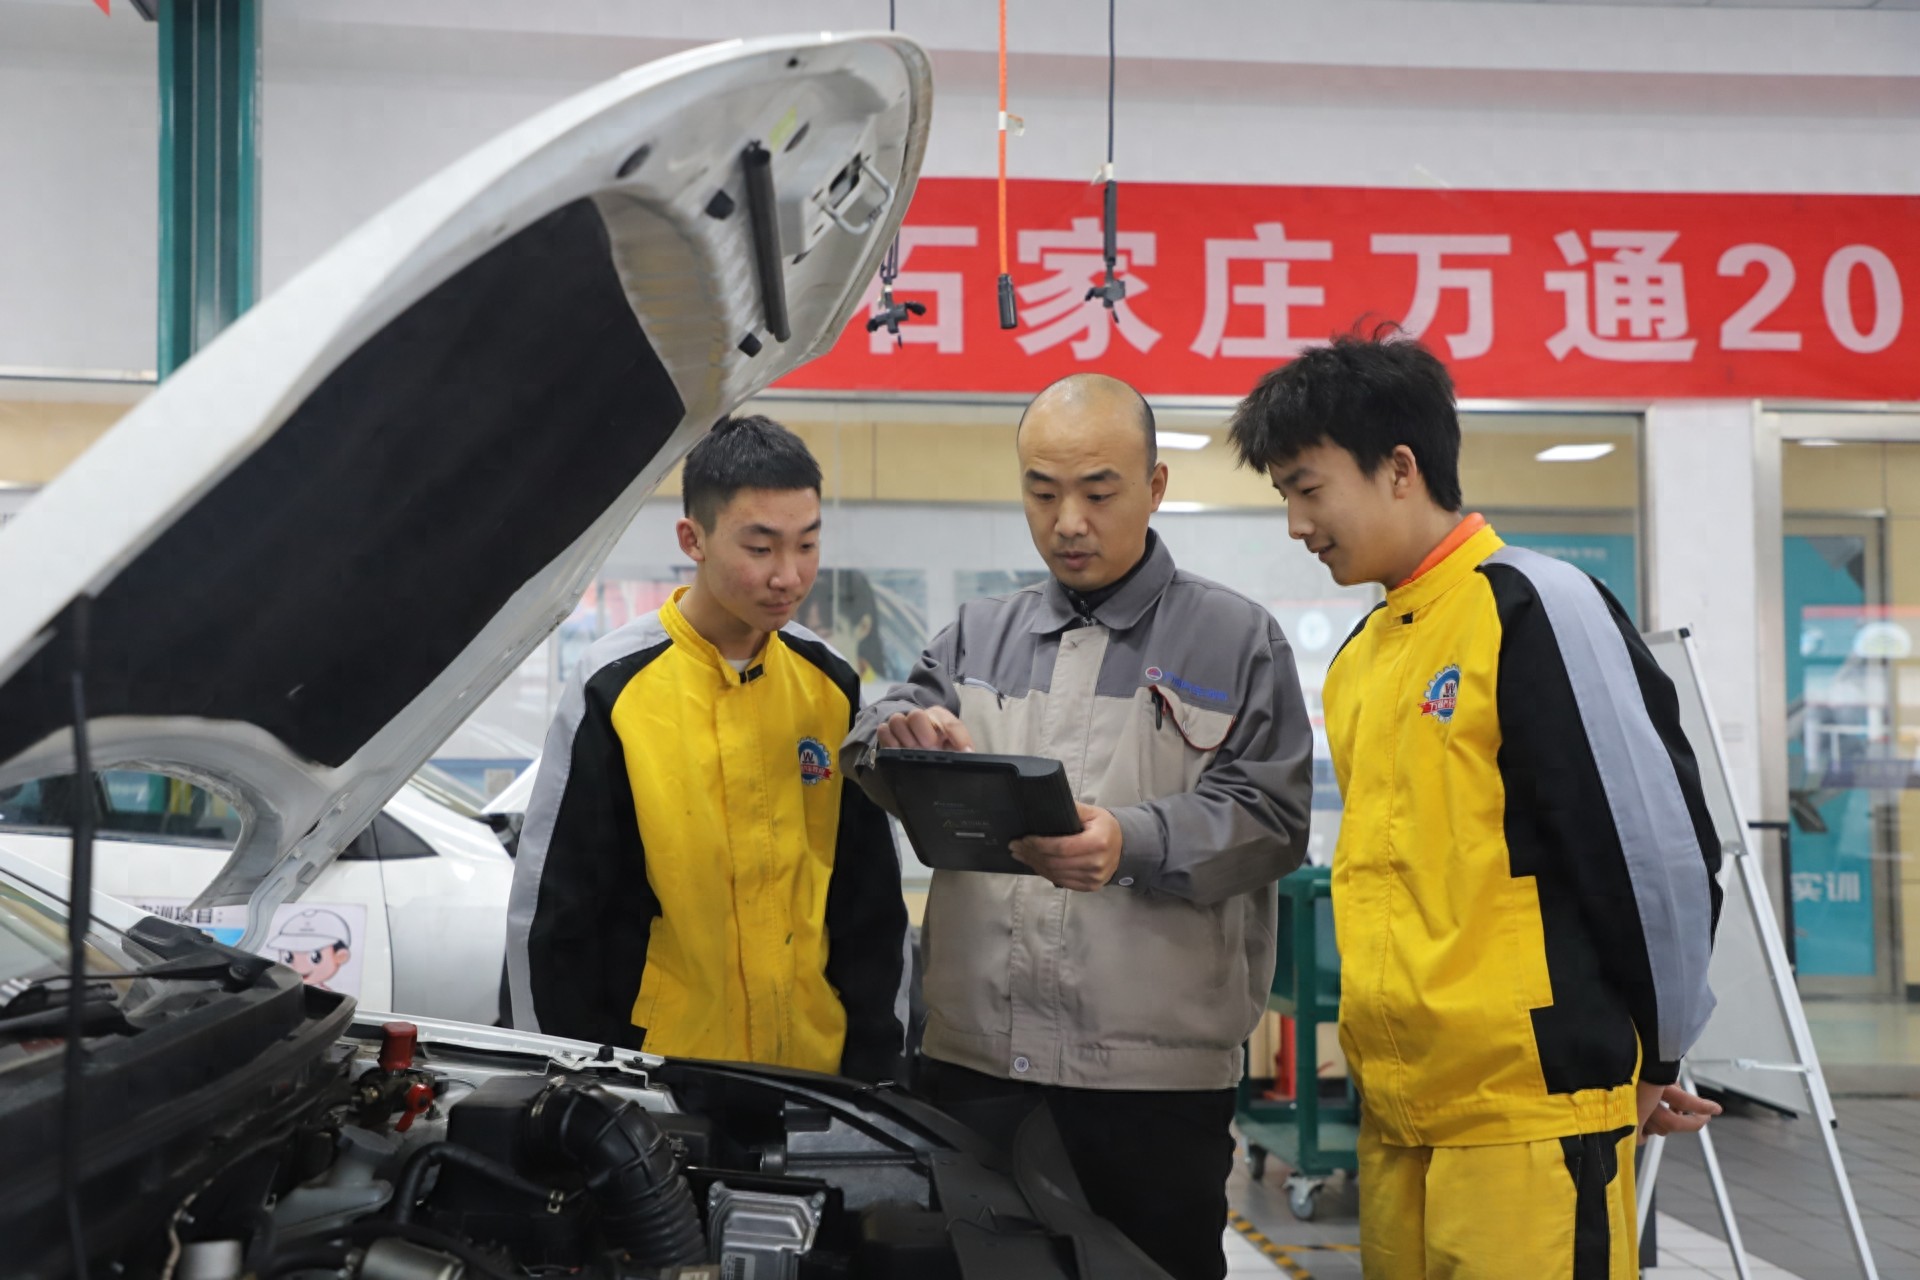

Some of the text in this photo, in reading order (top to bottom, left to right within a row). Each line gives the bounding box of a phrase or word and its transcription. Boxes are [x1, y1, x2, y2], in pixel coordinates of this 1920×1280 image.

[850, 217, 1904, 362] 石家庄万通20
[1789, 871, 1860, 902] 实训
